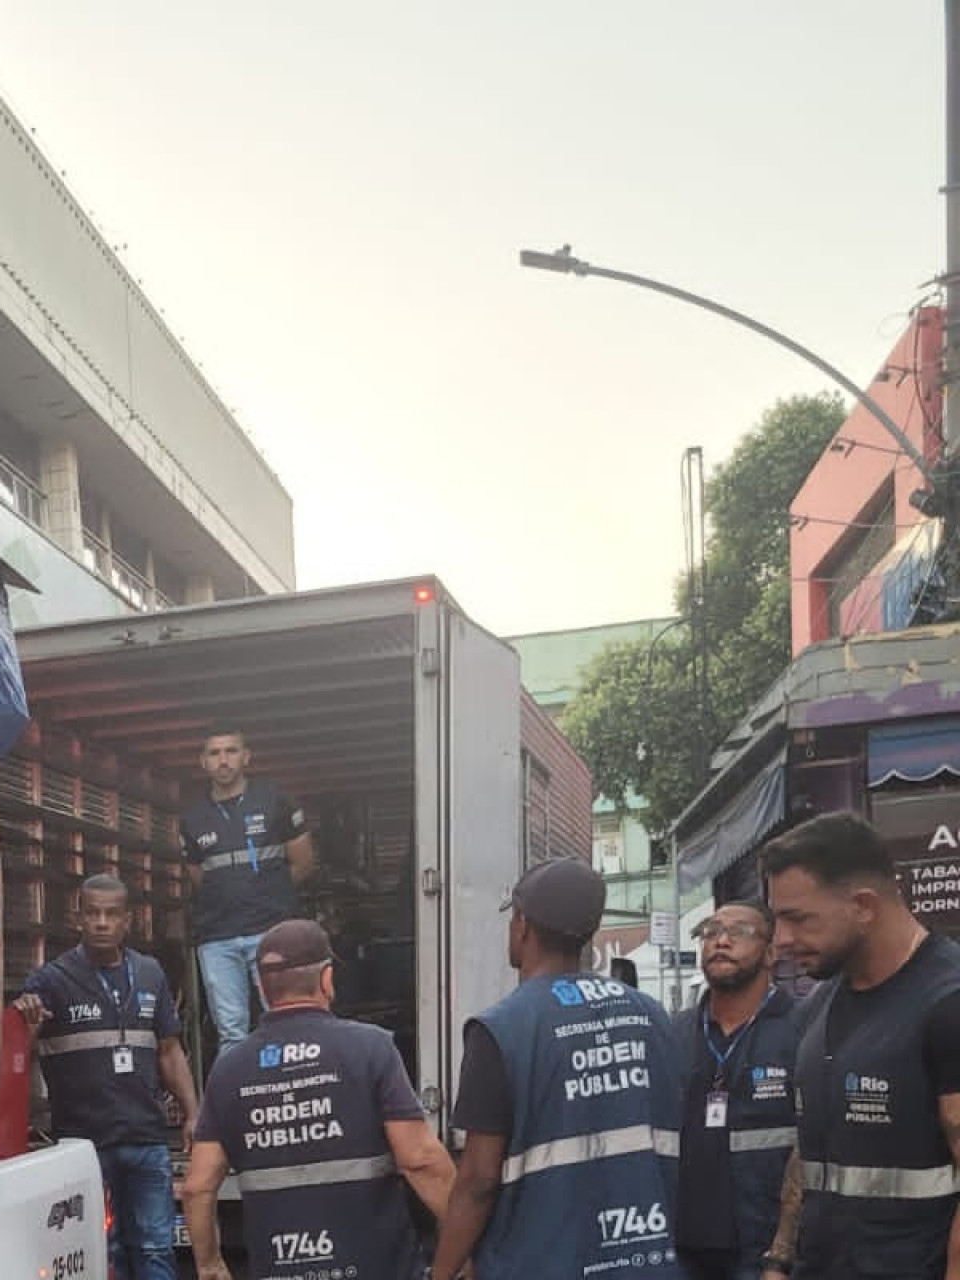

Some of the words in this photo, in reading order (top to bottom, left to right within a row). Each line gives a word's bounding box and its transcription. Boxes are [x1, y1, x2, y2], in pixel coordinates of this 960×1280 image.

[927, 823, 960, 850] A
[912, 864, 960, 881] TABA
[576, 978, 625, 1001] Rio
[69, 1002, 102, 1023] 1746
[282, 1042, 321, 1064] Rio
[860, 1076, 889, 1092] Rio
[250, 1096, 333, 1126] ORDEM
[244, 1119, 344, 1150] PÚBLICA
[598, 1203, 667, 1241] 1746
[271, 1229, 334, 1259] 1746
